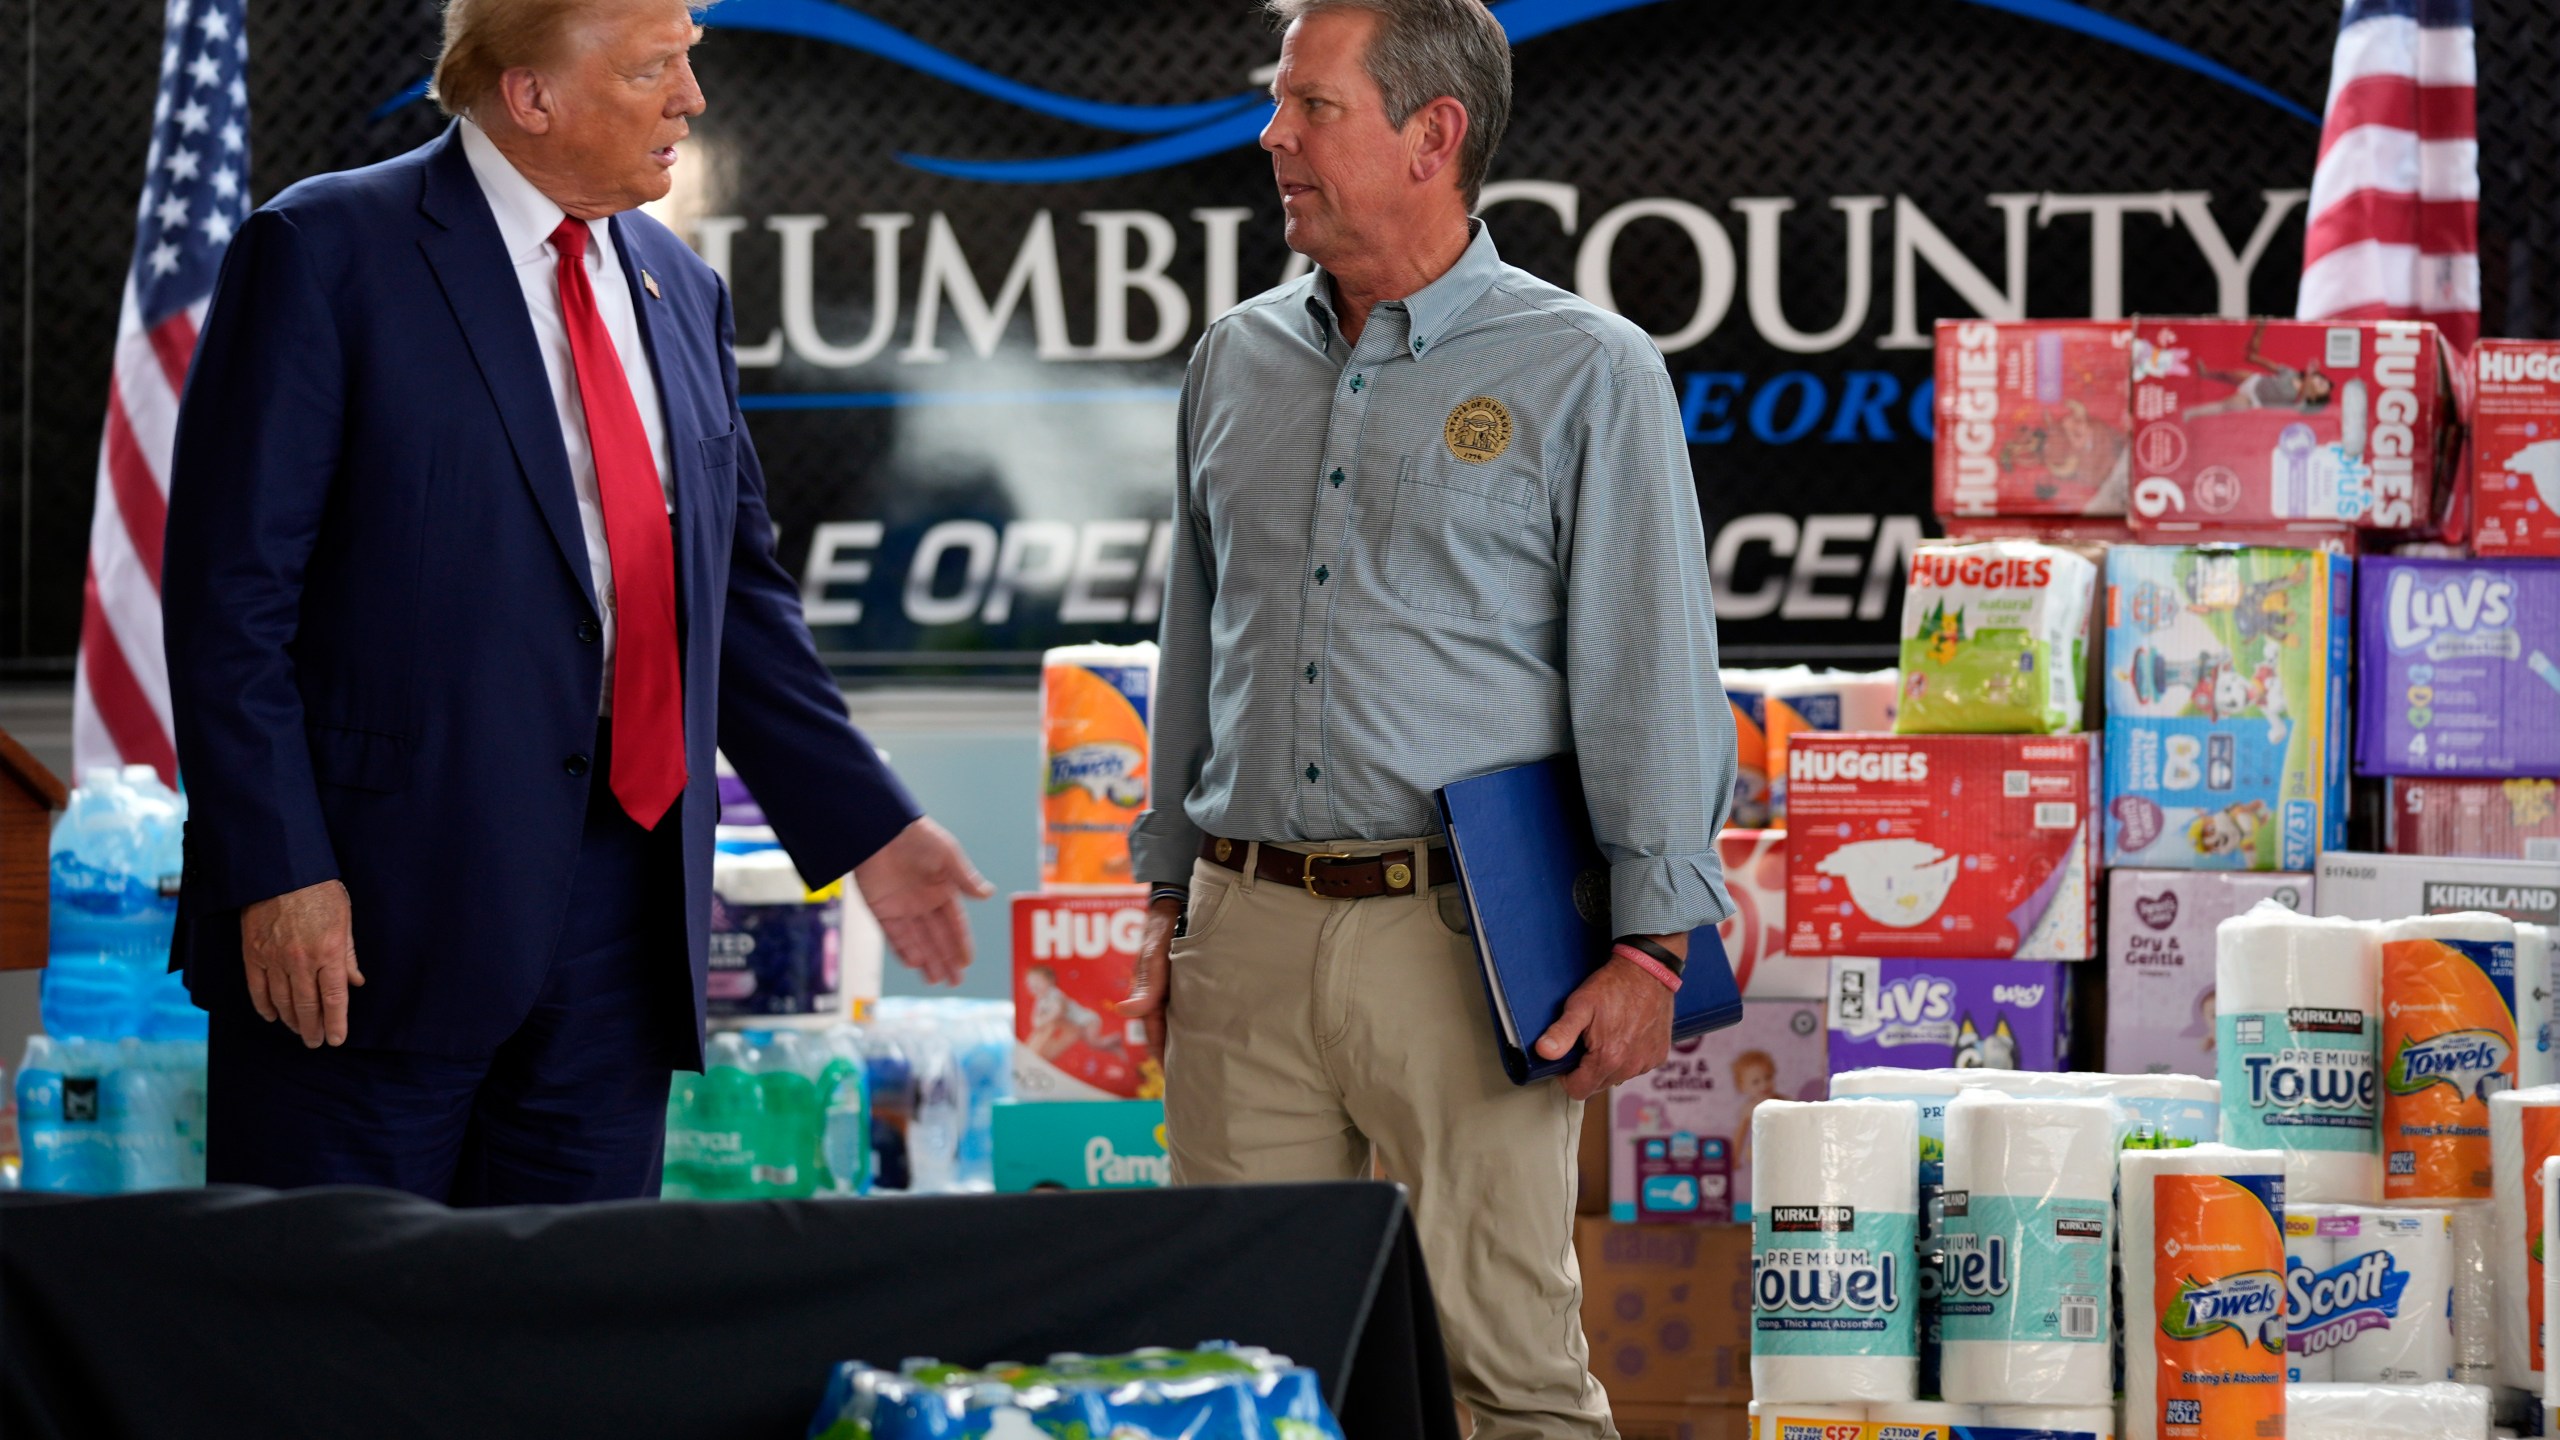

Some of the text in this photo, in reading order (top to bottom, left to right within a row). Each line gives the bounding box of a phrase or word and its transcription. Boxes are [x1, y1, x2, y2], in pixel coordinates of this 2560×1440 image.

[690, 206, 1312, 368] LUMBI
[1953, 321, 1998, 517] HUGGIES
[2370, 320, 2422, 529] HUGGIES
[1464, 452, 1482, 460] 1776
[1909, 552, 2053, 590] HUGGIES
[1789, 749, 1929, 783] HUGGIES
[2429, 884, 2557, 912] KIRKLAND
[2130, 935, 2180, 952] Dry &
[2125, 951, 2185, 967] Gentle
[2290, 1009, 2362, 1025] KIRKLAND
[2283, 1051, 2372, 1066] PREMIUM
[2402, 1042, 2497, 1083] Towels
[1774, 1208, 1852, 1222] KIRKLAND
[2058, 1221, 2103, 1232] KIRKLAND
[1768, 1252, 1865, 1266] PREMIUM
[2286, 1251, 2389, 1326] Scott
[2183, 1283, 2277, 1328] Towels
[1784, 1318, 1810, 1328] Thick
[1811, 1318, 1829, 1329] and
[1832, 1318, 1885, 1329] Absorbent
[2301, 1317, 2358, 1357] 1000
[2182, 1372, 2280, 1386] Strong & Absorbent
[2168, 1401, 2201, 1411] MEGA
[2166, 1411, 2200, 1424] ROLL
[1783, 1425, 1823, 1434] PER ROLL
